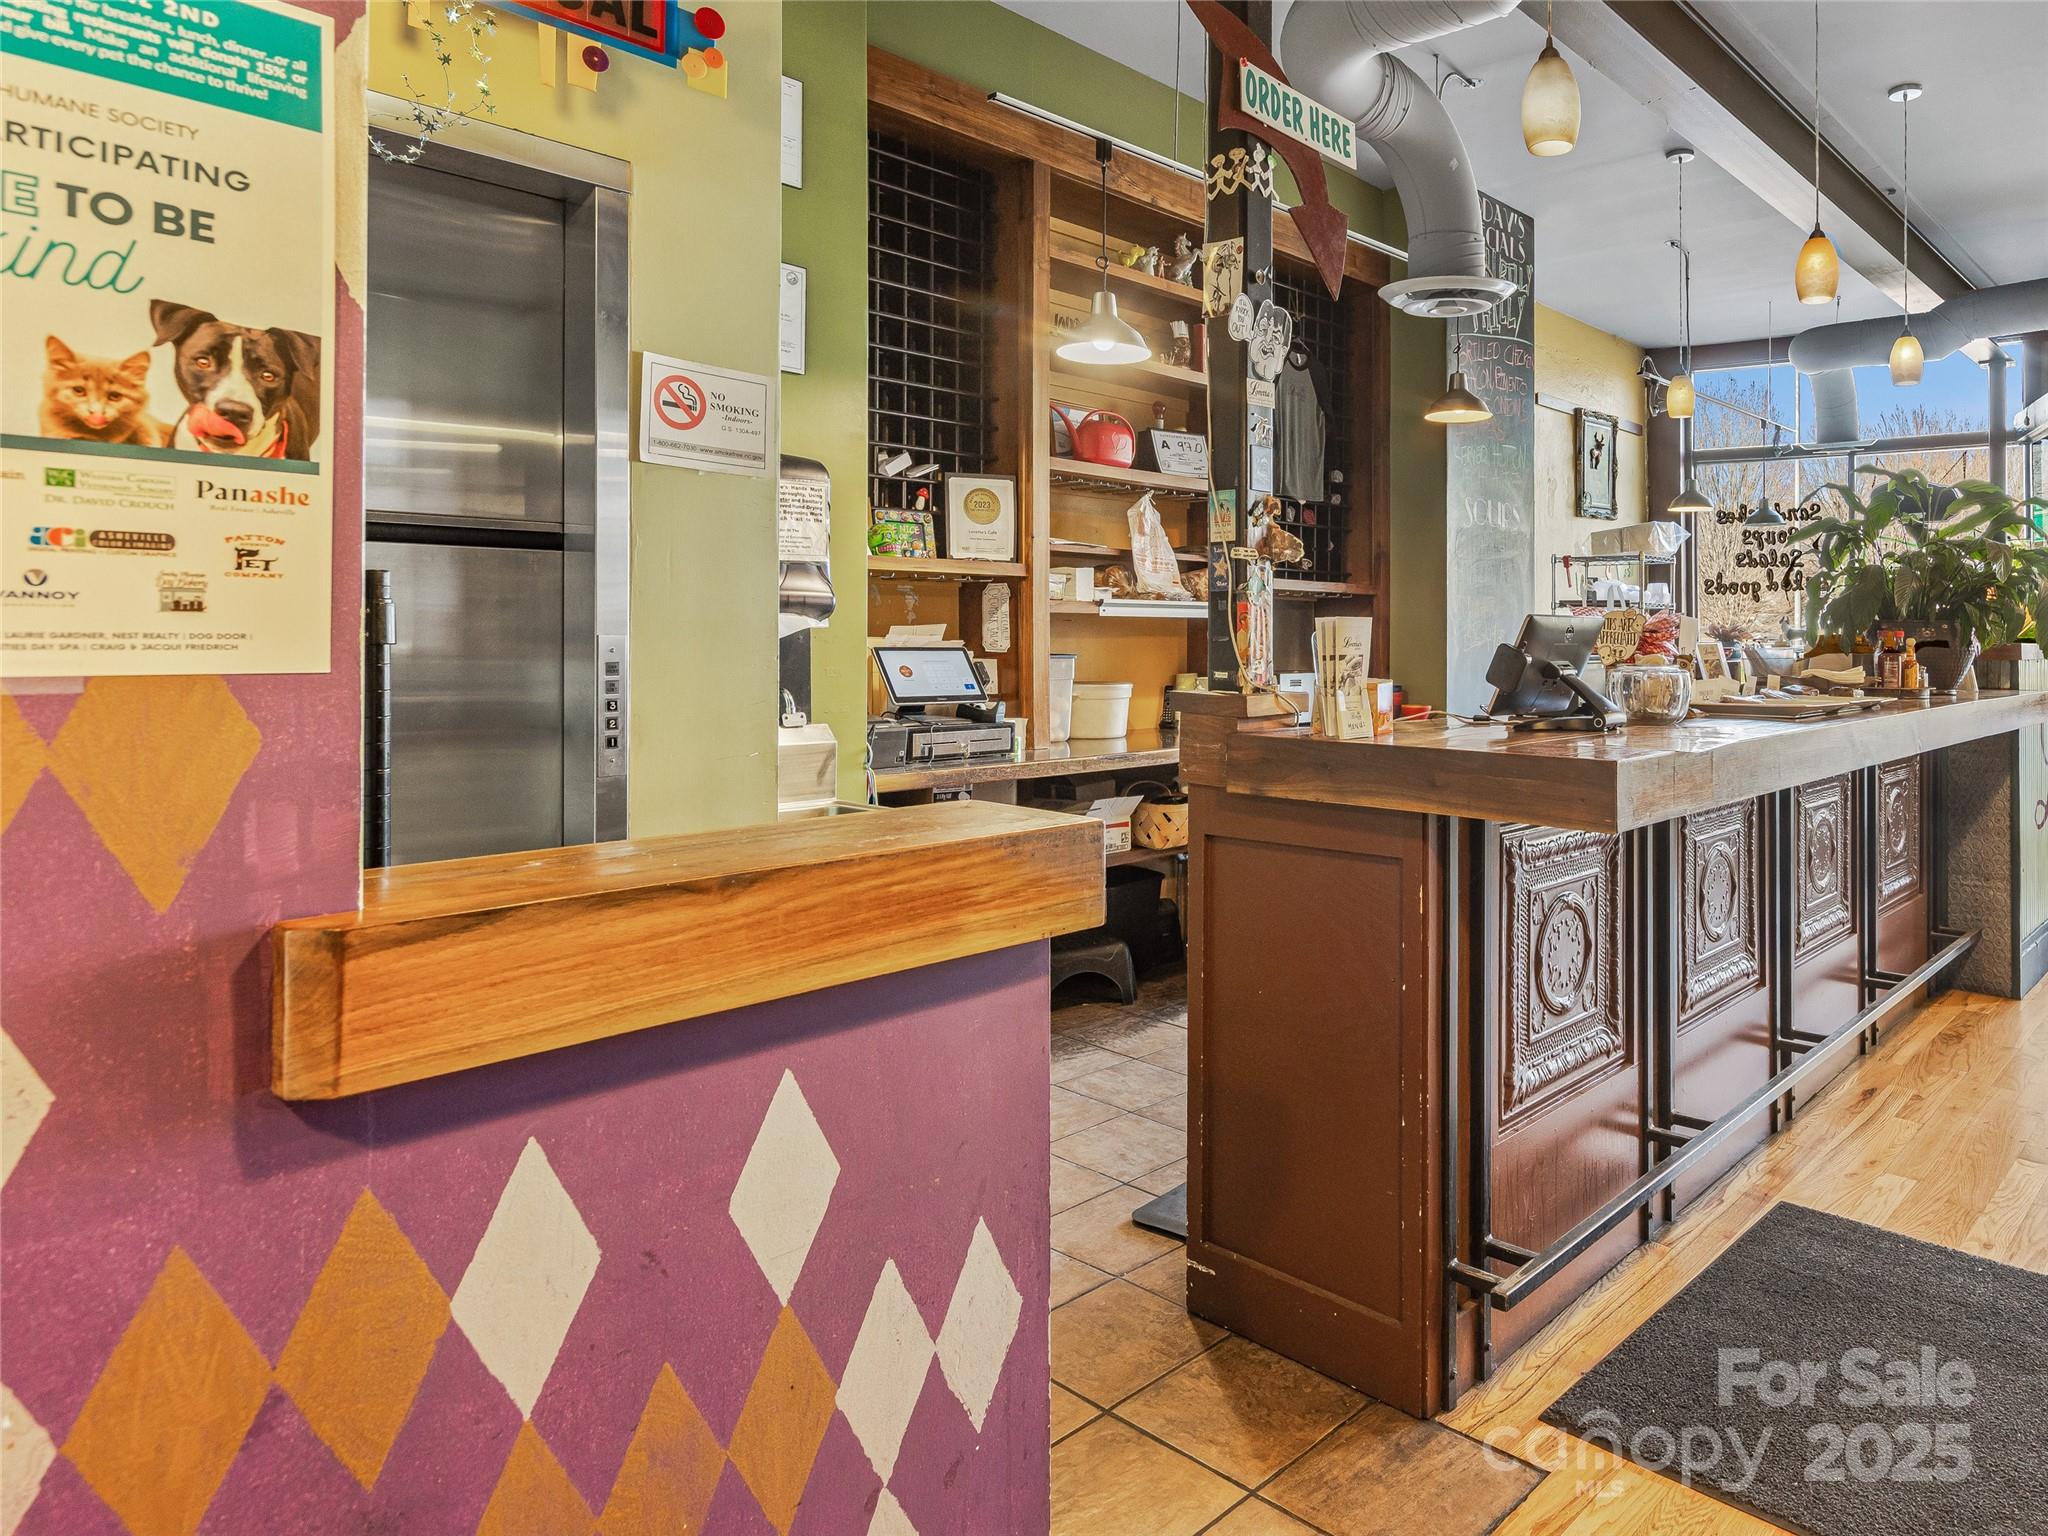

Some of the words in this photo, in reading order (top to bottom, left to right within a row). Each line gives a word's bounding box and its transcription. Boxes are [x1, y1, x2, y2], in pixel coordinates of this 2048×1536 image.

[163, 1, 221, 28] 2ND
[199, 47, 251, 69] donate
[255, 62, 287, 80] 15%
[291, 73, 308, 84] or
[108, 107, 200, 141] SOCIETY
[1245, 69, 1304, 135] ORDER
[1309, 104, 1352, 159] HERE
[1, 120, 251, 192] RTICIPATING
[56, 182, 133, 226] TO
[154, 201, 216, 244] BE
[1481, 197, 1525, 239] DAY'S
[1484, 226, 1526, 264] CIALS
[0, 225, 145, 294] ind
[710, 391, 726, 402] NO
[710, 402, 760, 418] SMOKING
[1161, 440, 1170, 450] A
[196, 479, 310, 506] Panashe
[973, 500, 991, 509] 2023
[1463, 497, 1520, 528] SOUPS
[98, 531, 168, 542] ASHEVILLE
[224, 534, 286, 545] PATTON
[235, 547, 279, 571] PET
[189, 632, 213, 640] DOG
[217, 632, 248, 640] DOOR
[609, 701, 617, 710] 3
[609, 719, 616, 728] 2
[611, 737, 615, 747] 1
